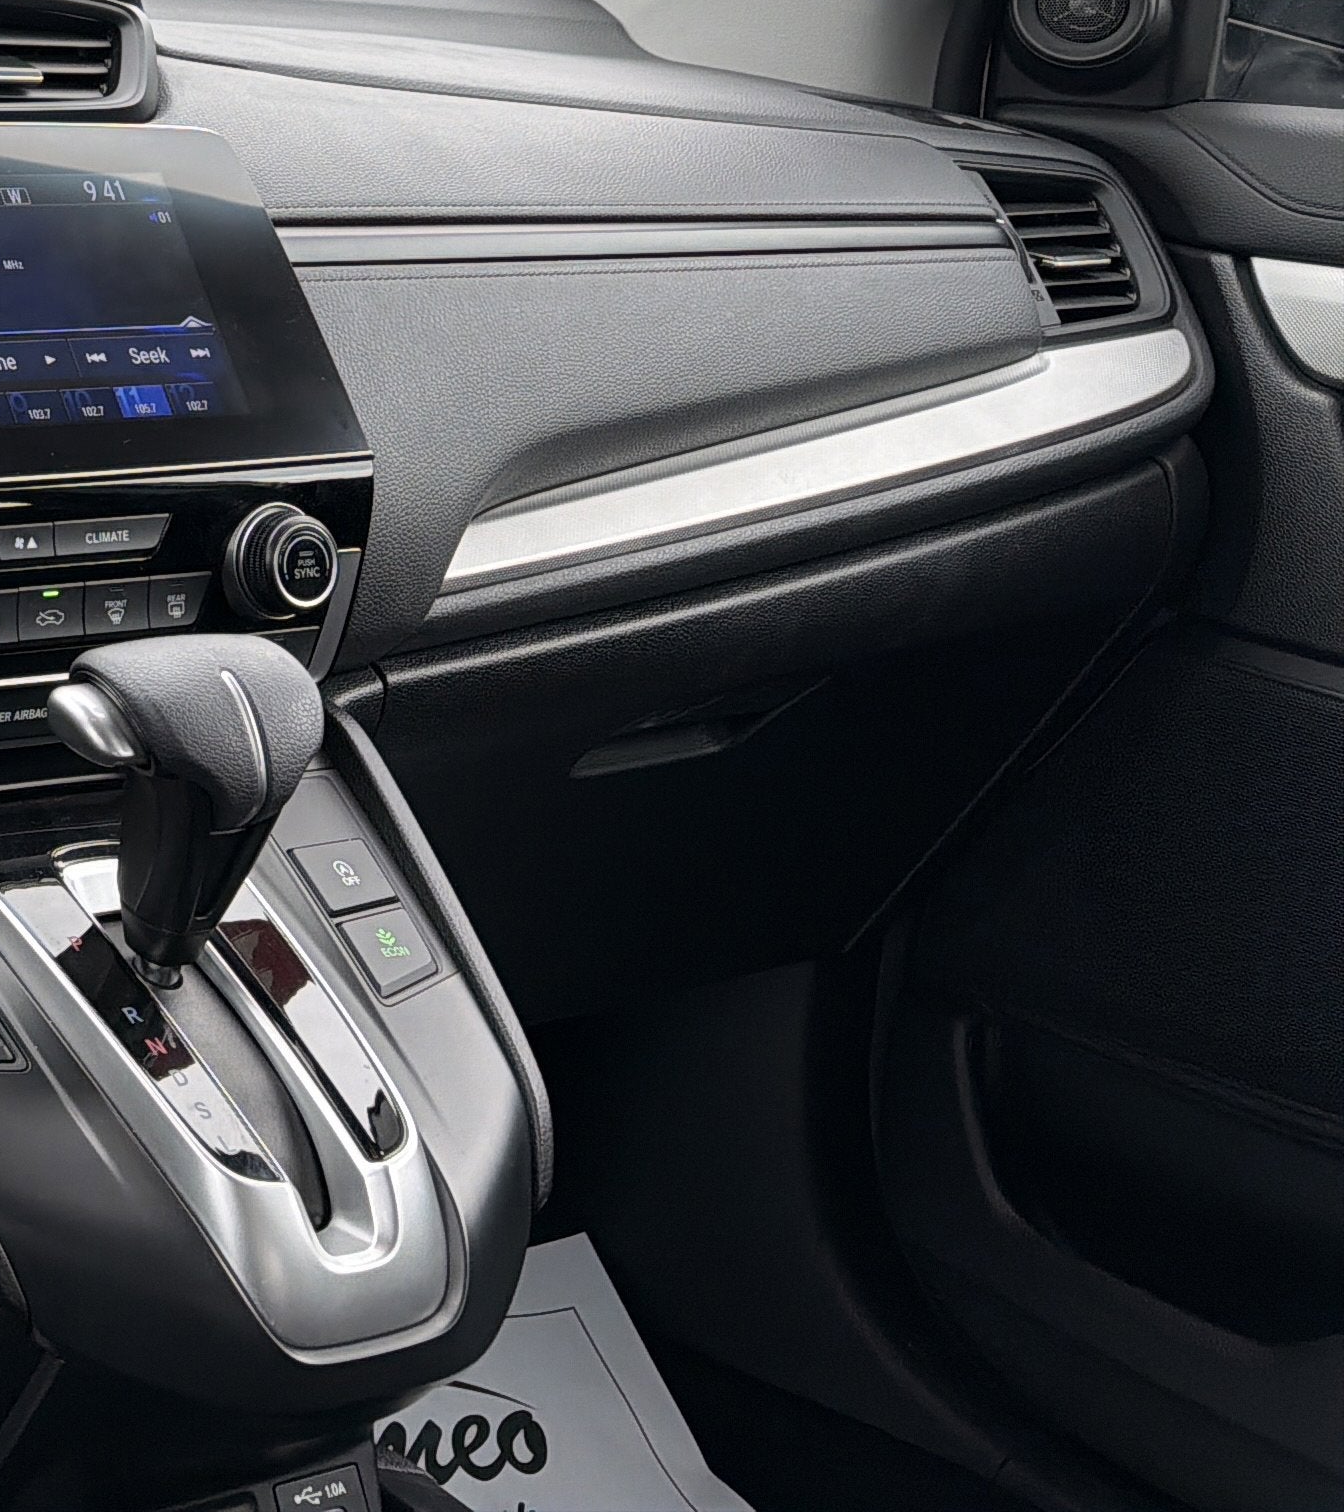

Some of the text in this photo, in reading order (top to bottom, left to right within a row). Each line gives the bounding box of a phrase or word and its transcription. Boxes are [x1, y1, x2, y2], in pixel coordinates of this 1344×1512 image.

[2, 258, 25, 271] MHz
[127, 346, 172, 365] Seek
[81, 405, 105, 418] 102.7
[134, 402, 158, 415] 105.7
[185, 399, 209, 412] 102.7
[26, 407, 51, 421] 103.7
[85, 529, 130, 544] CLIMATE
[294, 567, 321, 580] SYNC
[104, 599, 128, 609] FRONT
[166, 593, 186, 603] REAR
[13, 707, 48, 722] AIRBAG
[120, 1006, 145, 1025] R
[144, 1037, 169, 1056] N
[194, 1101, 213, 1120] S
[324, 1481, 348, 1500] 1.0A
